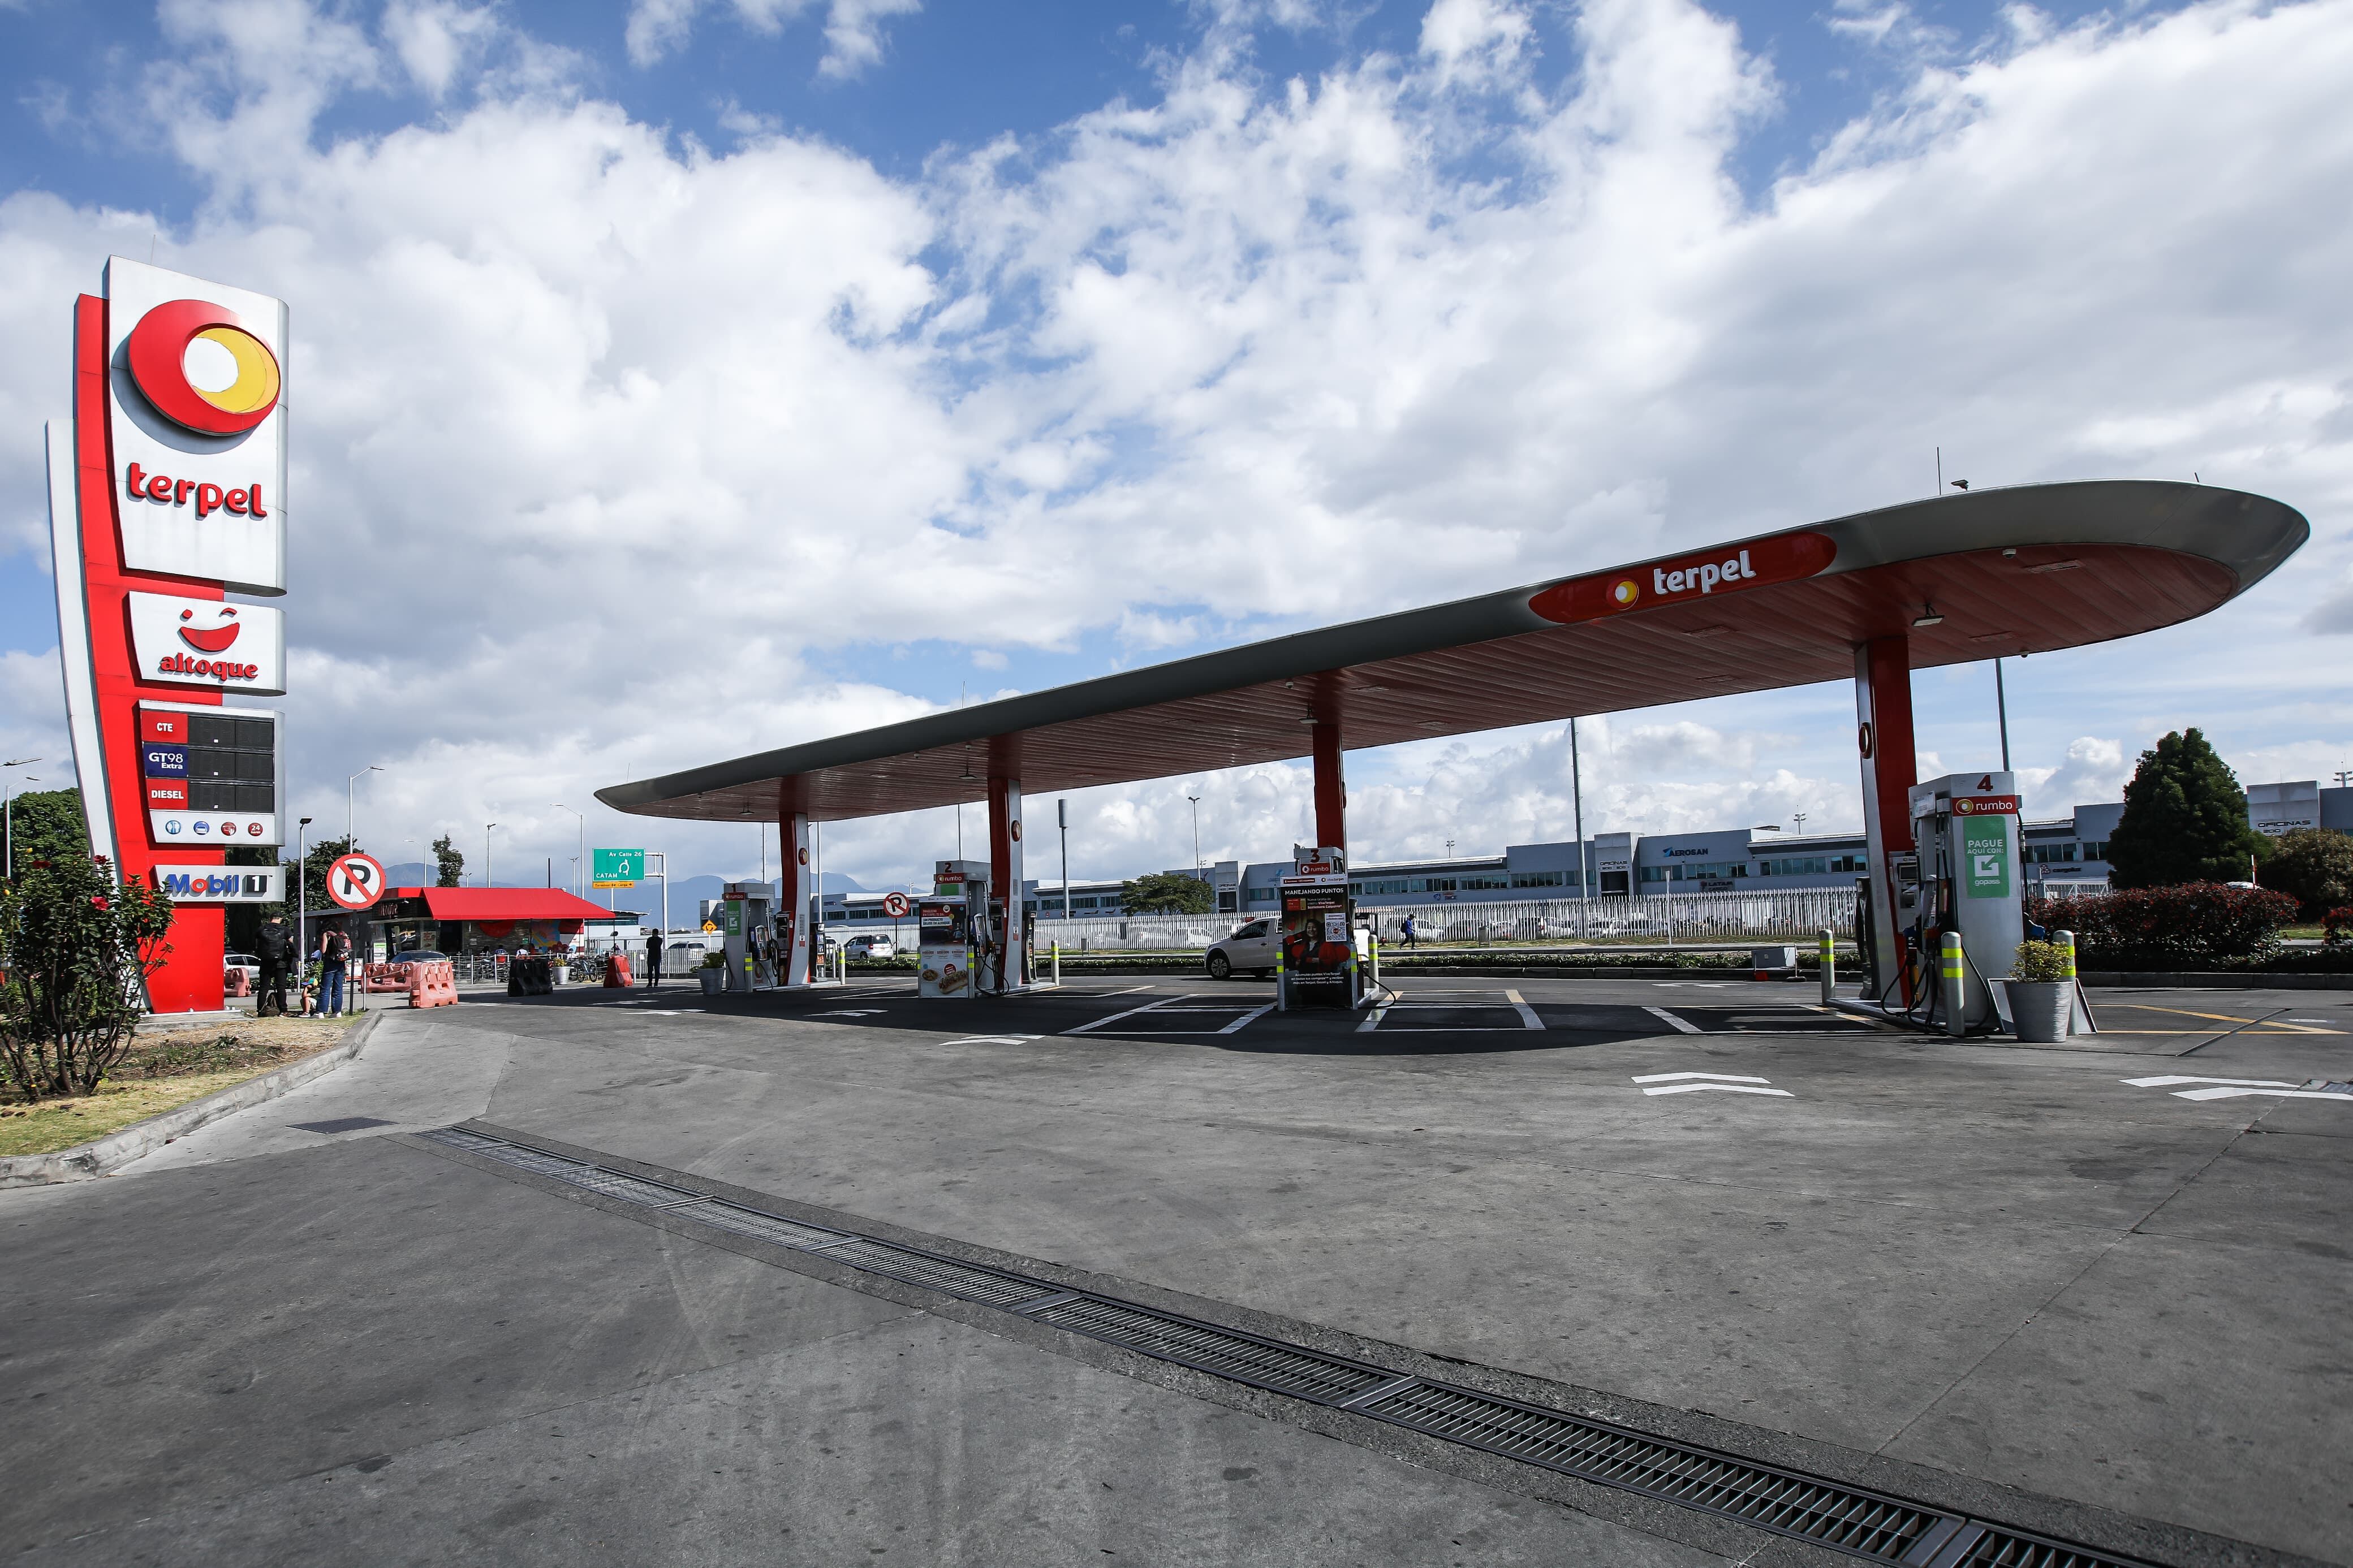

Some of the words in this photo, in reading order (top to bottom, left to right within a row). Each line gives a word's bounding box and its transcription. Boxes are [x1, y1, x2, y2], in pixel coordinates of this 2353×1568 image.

[130, 462, 267, 517] terpel
[1653, 550, 1756, 595] terpel
[160, 653, 258, 681] altoque
[157, 723, 173, 732] CTE
[149, 752, 183, 763] GT98
[1977, 774, 1993, 792] 4
[151, 790, 184, 799] DIESEL
[1976, 801, 2012, 810] rumbo
[1310, 849, 1320, 863] 3
[945, 862, 952, 872] 2
[169, 874, 239, 892] Mobil
[344, 863, 370, 895] P
